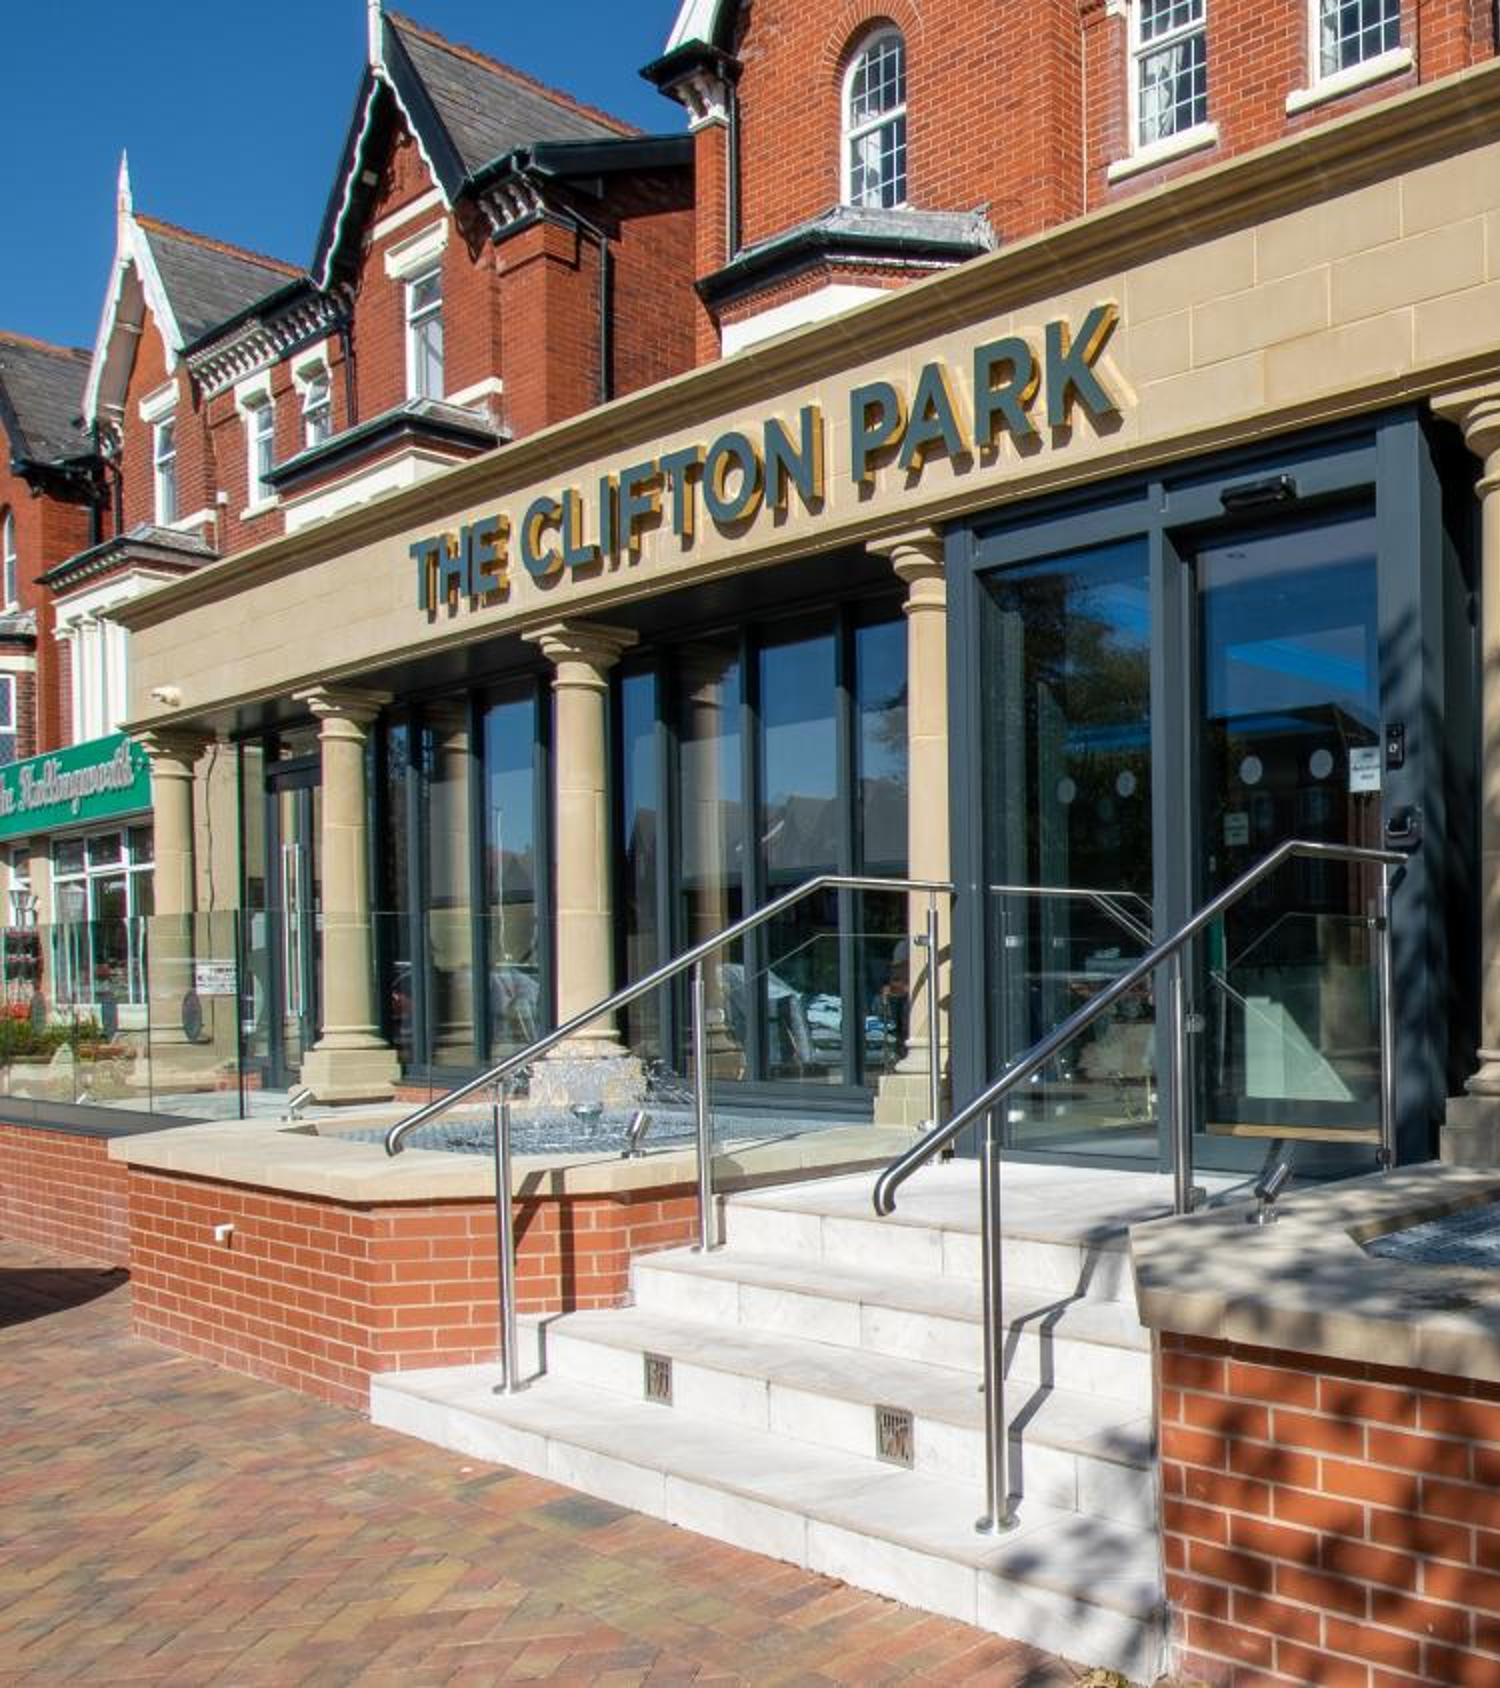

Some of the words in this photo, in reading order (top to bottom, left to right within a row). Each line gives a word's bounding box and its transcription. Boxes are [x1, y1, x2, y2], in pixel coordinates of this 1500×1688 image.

[409, 513, 511, 612] THE
[520, 403, 822, 578] CLIFTON
[850, 302, 1122, 483] PARK
